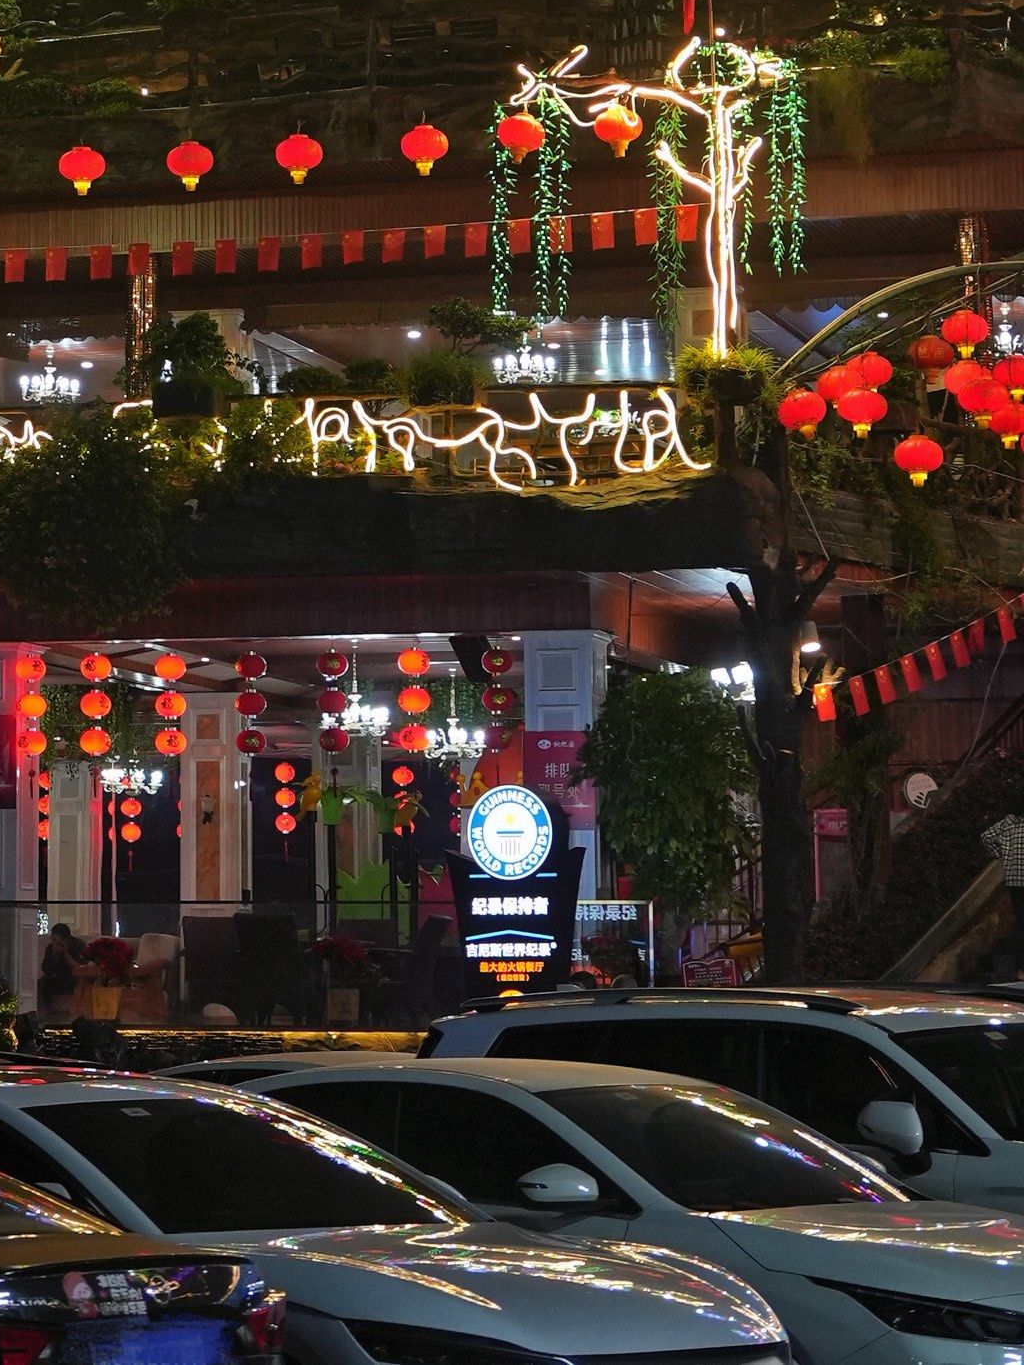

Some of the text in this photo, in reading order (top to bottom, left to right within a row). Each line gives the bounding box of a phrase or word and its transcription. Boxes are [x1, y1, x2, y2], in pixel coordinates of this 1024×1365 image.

[478, 789, 542, 816] GUINNESS
[472, 825, 549, 875] WORLD RECORDS
[471, 896, 550, 915] 纪录保持者
